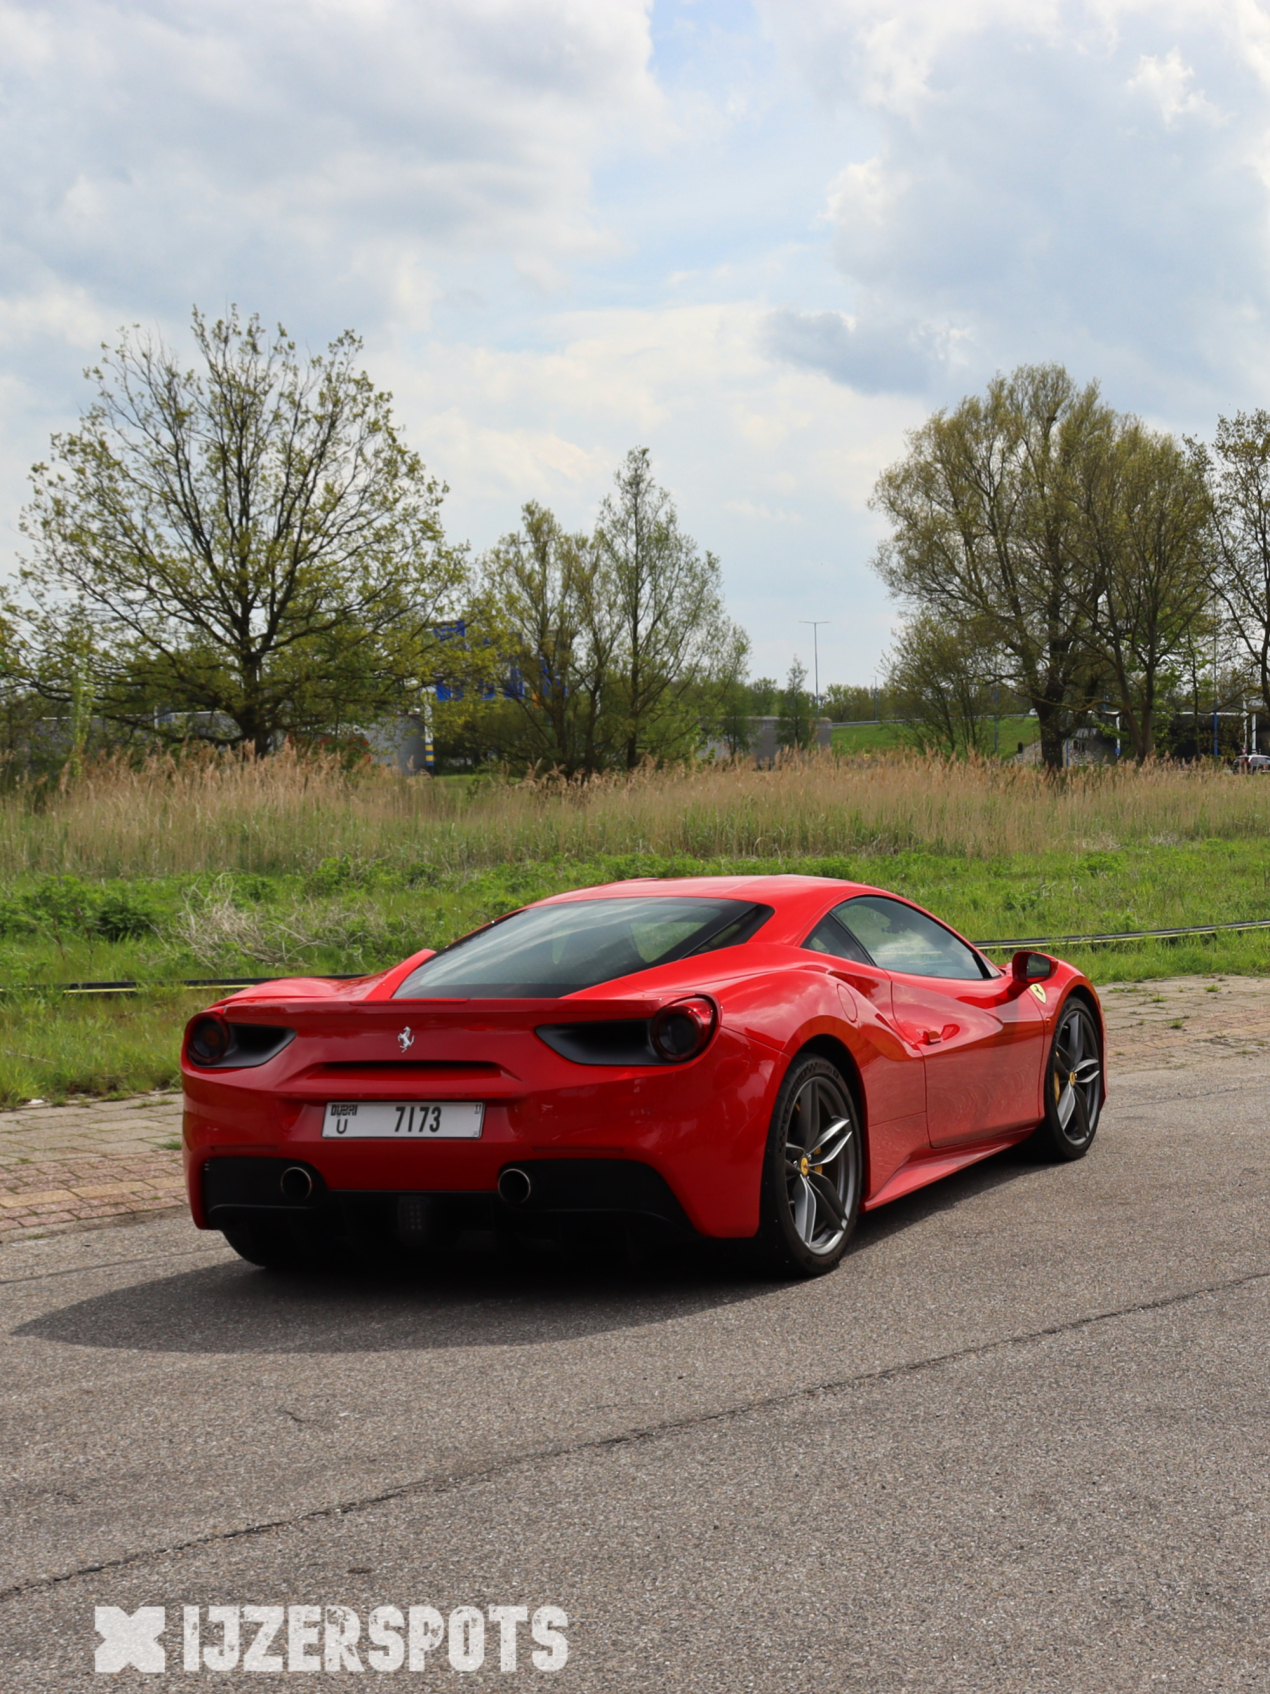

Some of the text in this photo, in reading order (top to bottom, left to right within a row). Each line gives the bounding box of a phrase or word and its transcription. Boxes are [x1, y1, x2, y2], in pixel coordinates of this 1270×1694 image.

[330, 1104, 358, 1116] DUBAI
[336, 1119, 348, 1135] U
[394, 1106, 442, 1133] 7173
